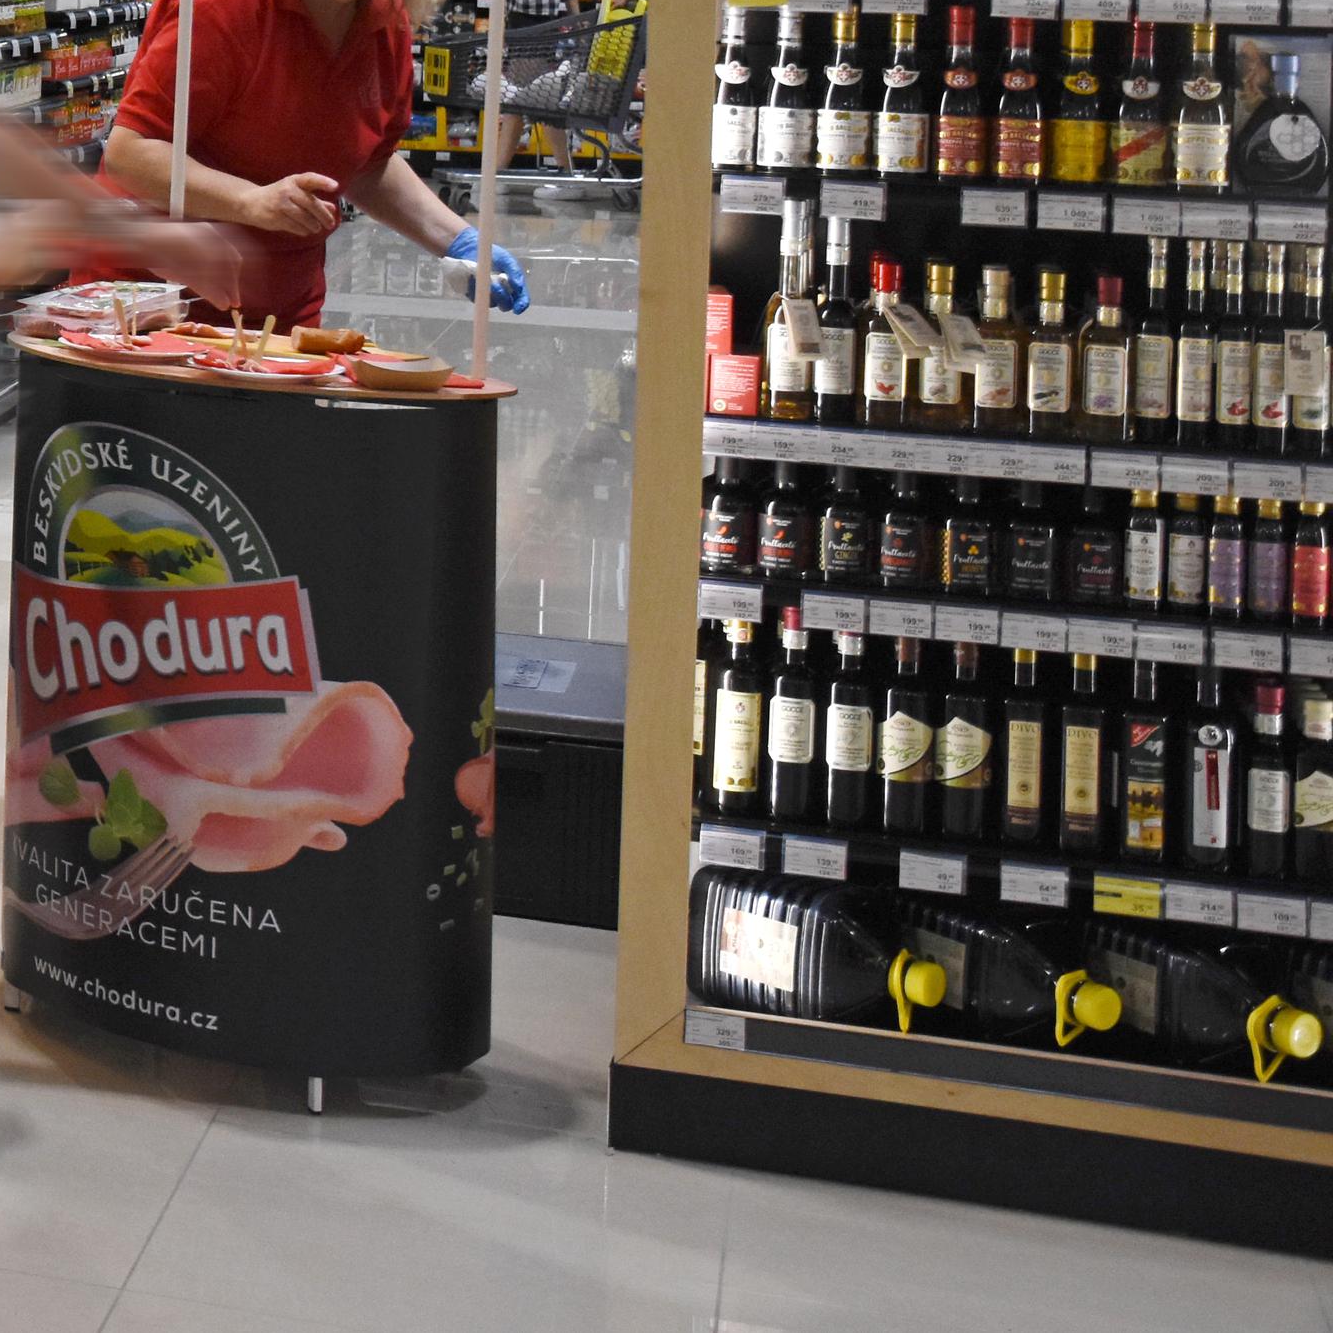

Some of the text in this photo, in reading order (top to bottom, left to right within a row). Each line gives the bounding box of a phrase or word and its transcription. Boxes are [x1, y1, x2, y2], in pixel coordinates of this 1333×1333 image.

[32, 437, 263, 578] BESKYDSKÉ UZENINY
[25, 597, 293, 699] Chodura
[35, 883, 217, 959] GENERACEMI
[99, 873, 282, 934] ZARUČENA
[34, 955, 219, 1031] www.chodura.cz
